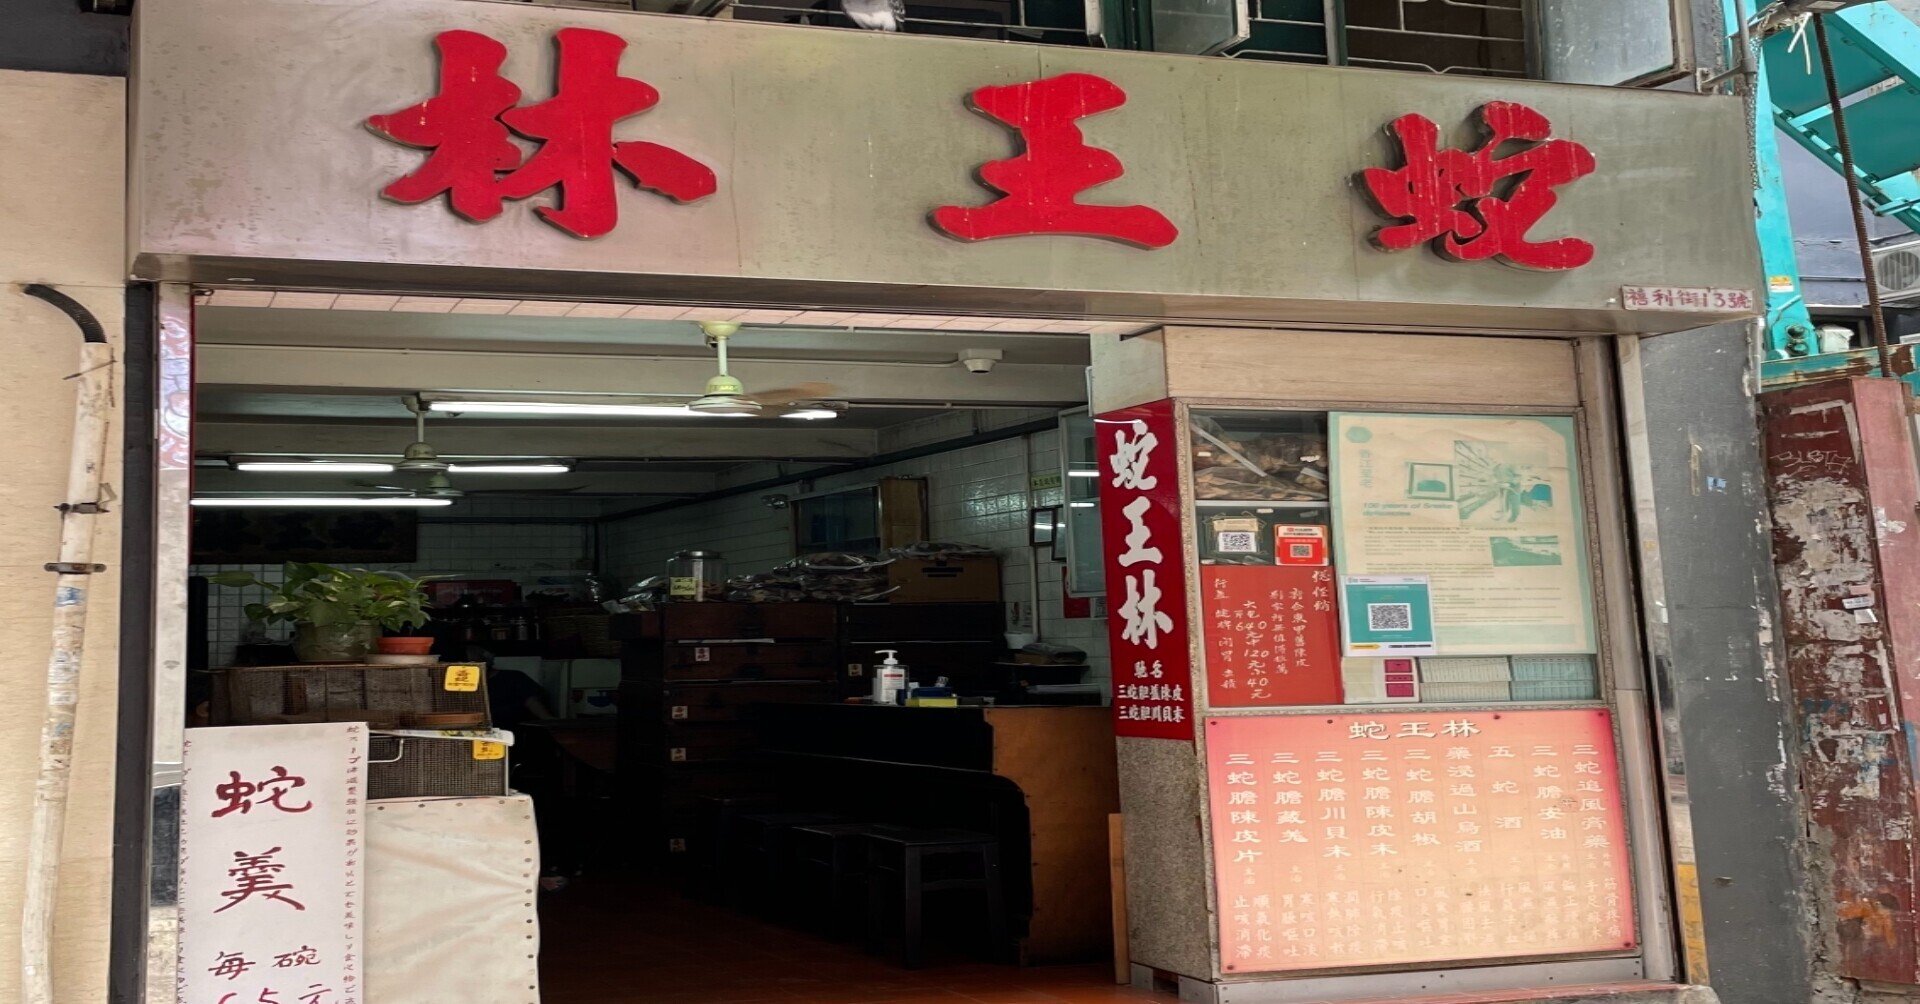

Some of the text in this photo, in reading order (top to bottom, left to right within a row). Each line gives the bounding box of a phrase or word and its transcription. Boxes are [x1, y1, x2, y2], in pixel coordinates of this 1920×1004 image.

[1110, 420, 1173, 649] 蛇王林
[1348, 719, 1482, 741] 蛇王林
[211, 765, 313, 913] 蛇羹
[1226, 752, 1264, 863] 三蛇膽陳皮片
[1315, 750, 1352, 859] 三蛇膽川貝末
[1360, 748, 1399, 857] 三蛇膽陳皮末
[1404, 748, 1442, 848] 三蛇膽胡椒
[1488, 745, 1524, 829] 五蛇酒
[1531, 744, 1568, 840] 三蛇膽安油
[208, 945, 321, 980] 每碗
